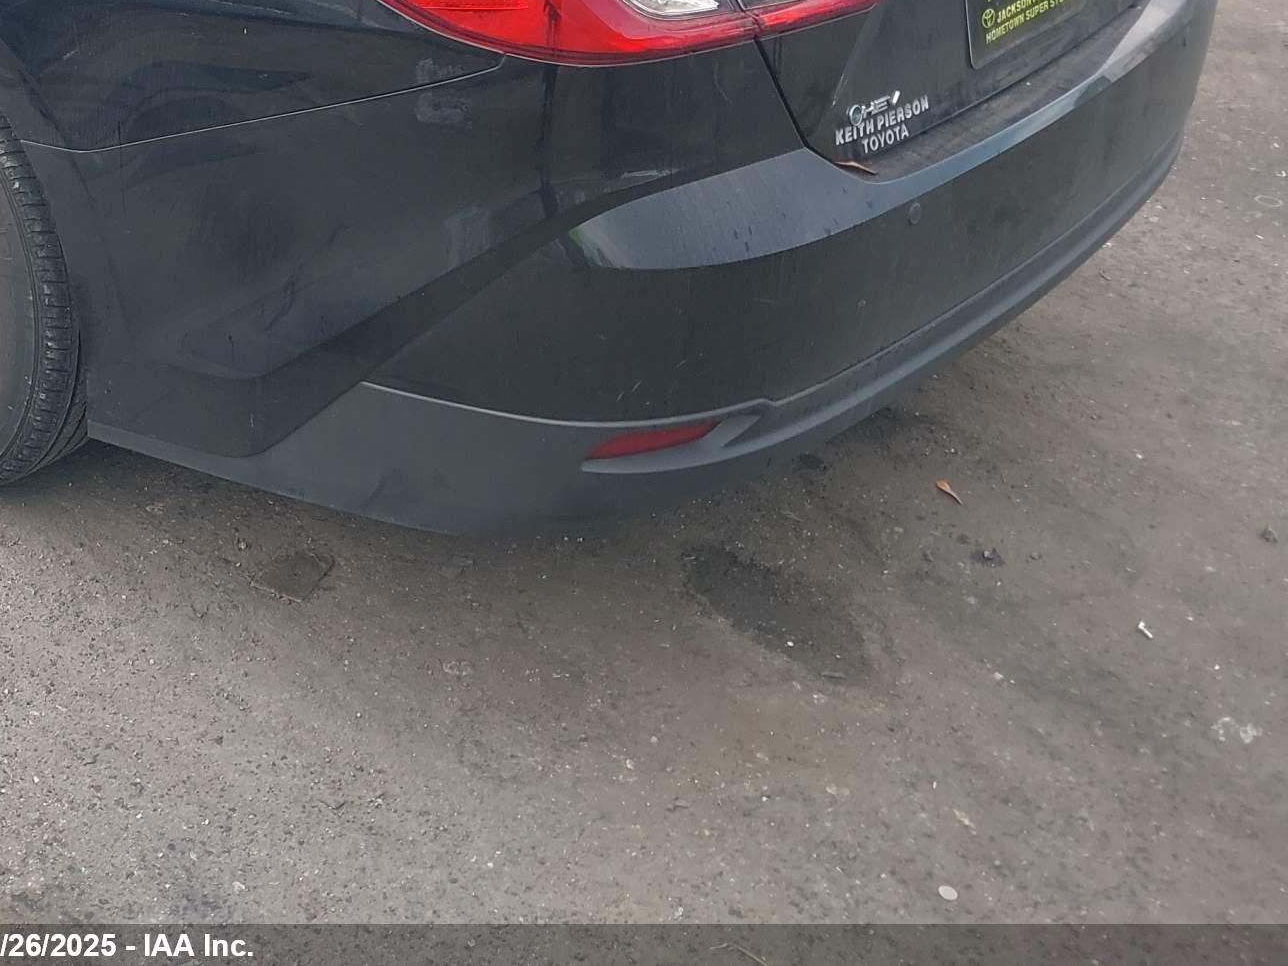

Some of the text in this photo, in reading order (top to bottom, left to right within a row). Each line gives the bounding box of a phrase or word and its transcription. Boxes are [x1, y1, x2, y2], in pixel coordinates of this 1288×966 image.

[985, 13, 1025, 44] HOMETOWN
[1025, 0, 1049, 21] SUPER
[835, 94, 929, 146] KEITH PIERSON
[861, 122, 910, 154] TOYOTA
